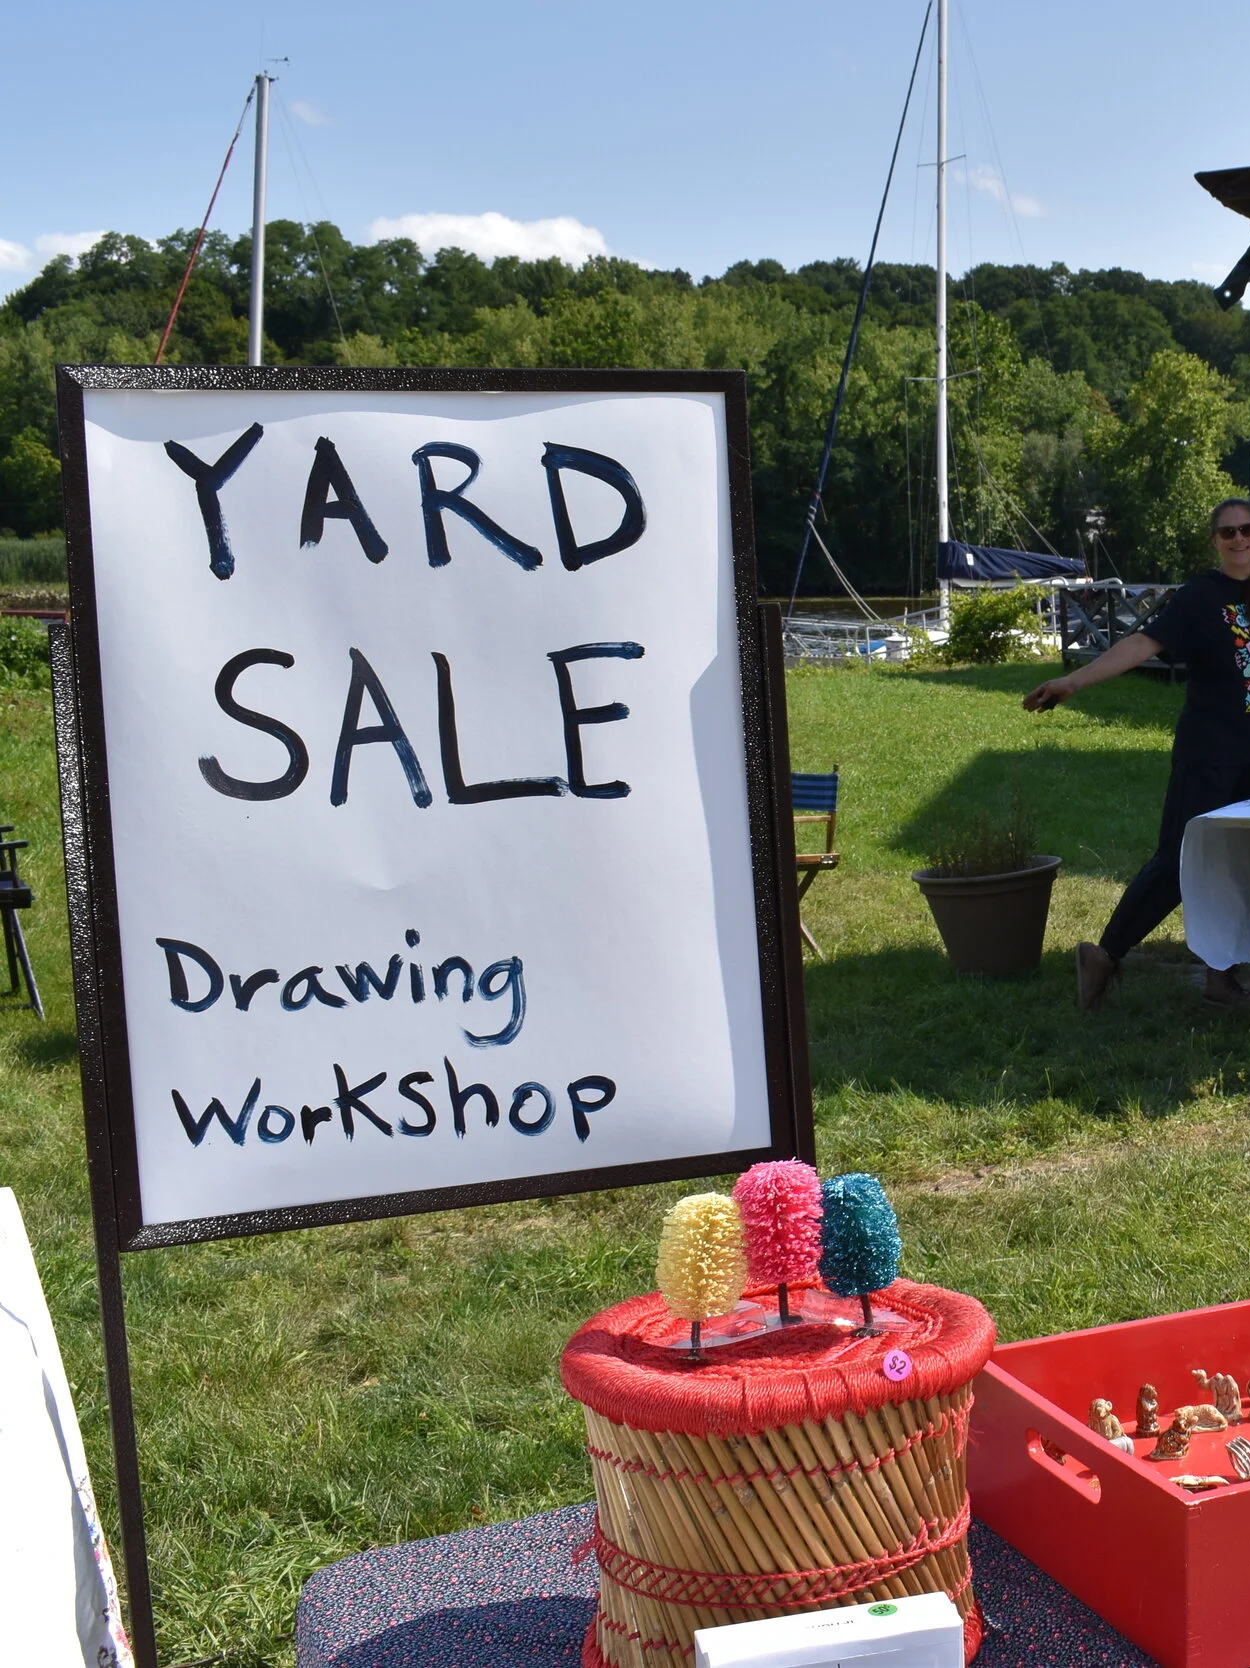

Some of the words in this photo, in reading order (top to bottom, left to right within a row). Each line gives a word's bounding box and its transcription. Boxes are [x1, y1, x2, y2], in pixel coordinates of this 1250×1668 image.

[164, 421, 648, 581] YARD
[198, 641, 646, 809] SALE
[156, 929, 527, 1048] Drawing
[889, 1355, 906, 1375] $2
